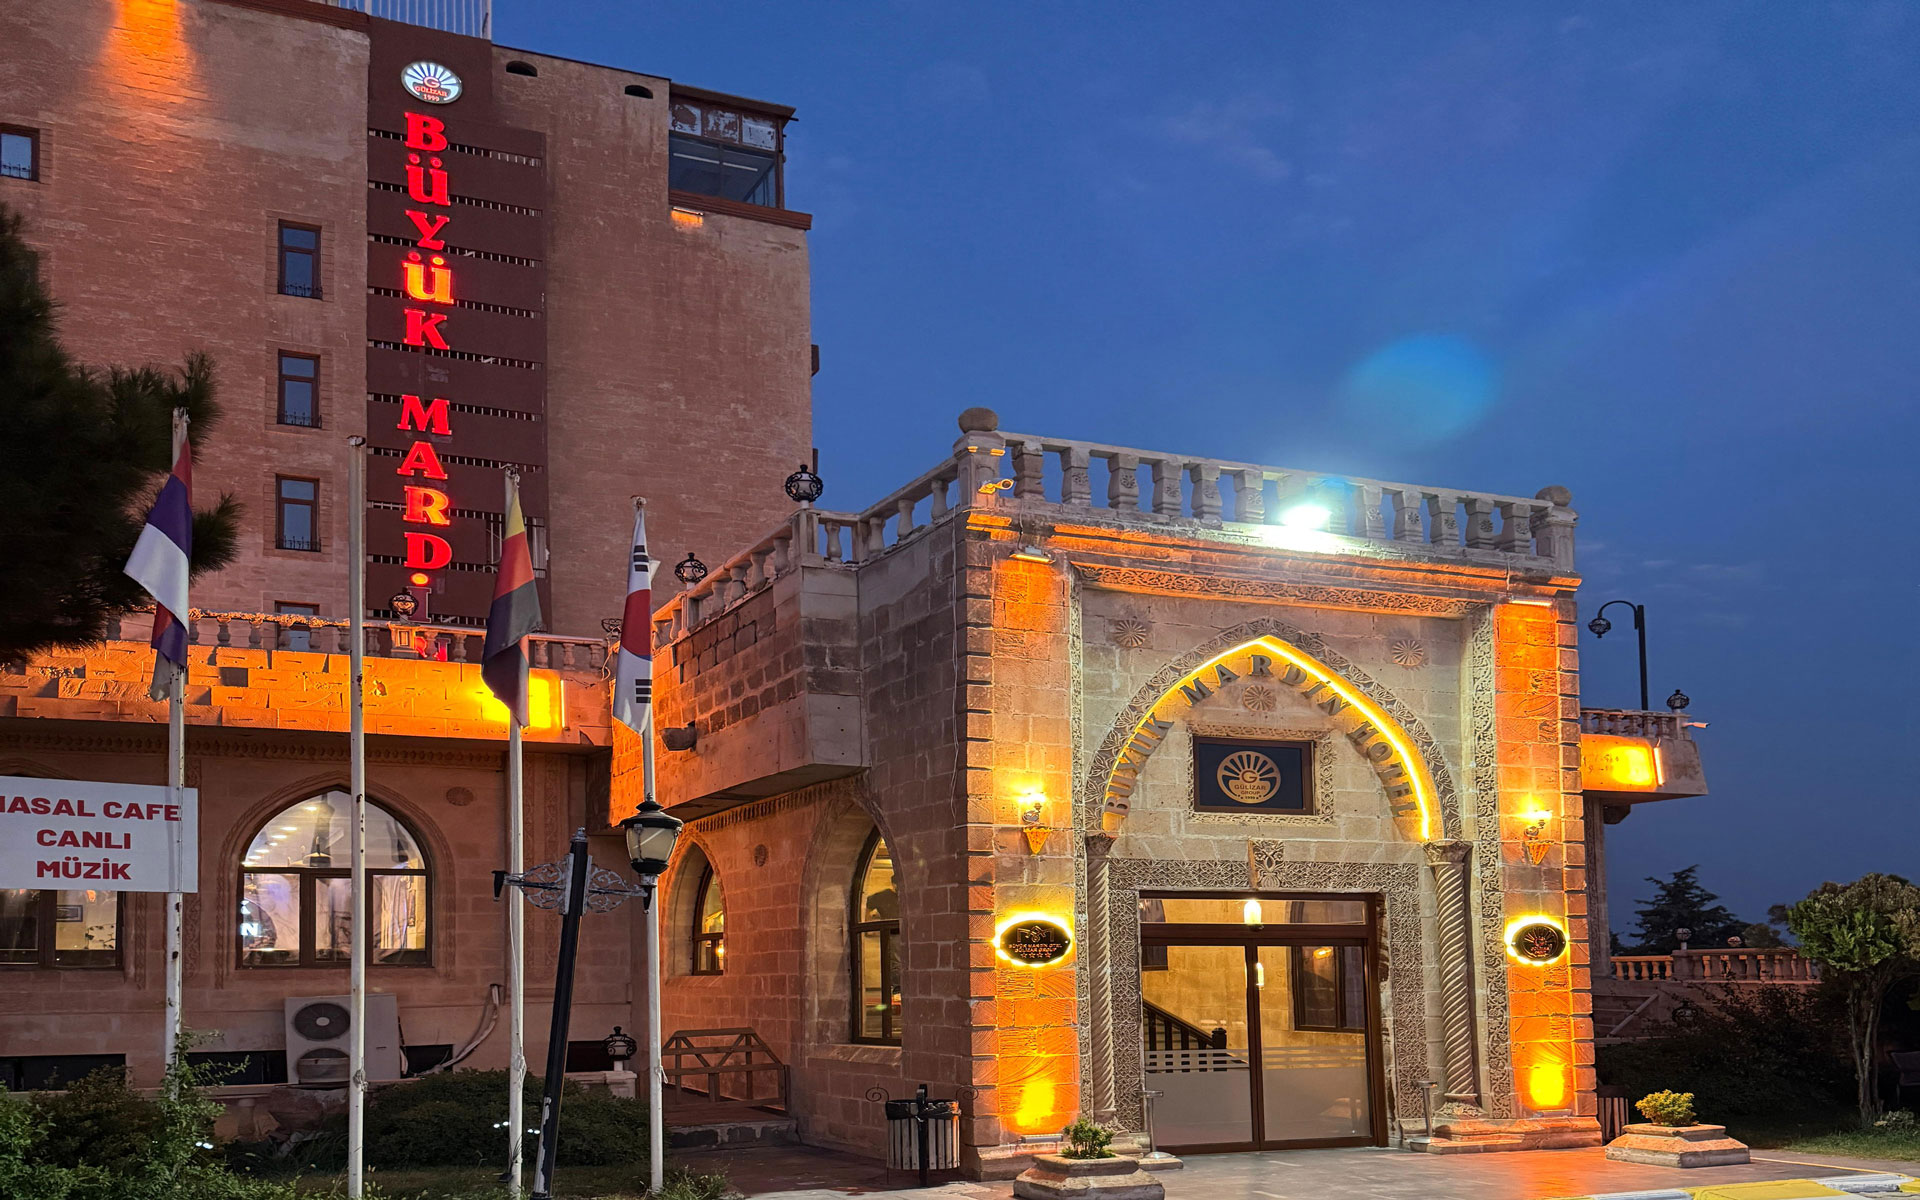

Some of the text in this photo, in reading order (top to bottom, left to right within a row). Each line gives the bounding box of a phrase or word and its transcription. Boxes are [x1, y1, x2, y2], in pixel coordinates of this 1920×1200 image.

[1179, 654, 1352, 717] MARDİN
[1346, 720, 1418, 818] HOTEL
[1242, 770, 1258, 783] G
[103, 801, 182, 821] CAFE
[36, 829, 131, 850] CANLI
[36, 856, 132, 880] MÜZİK
